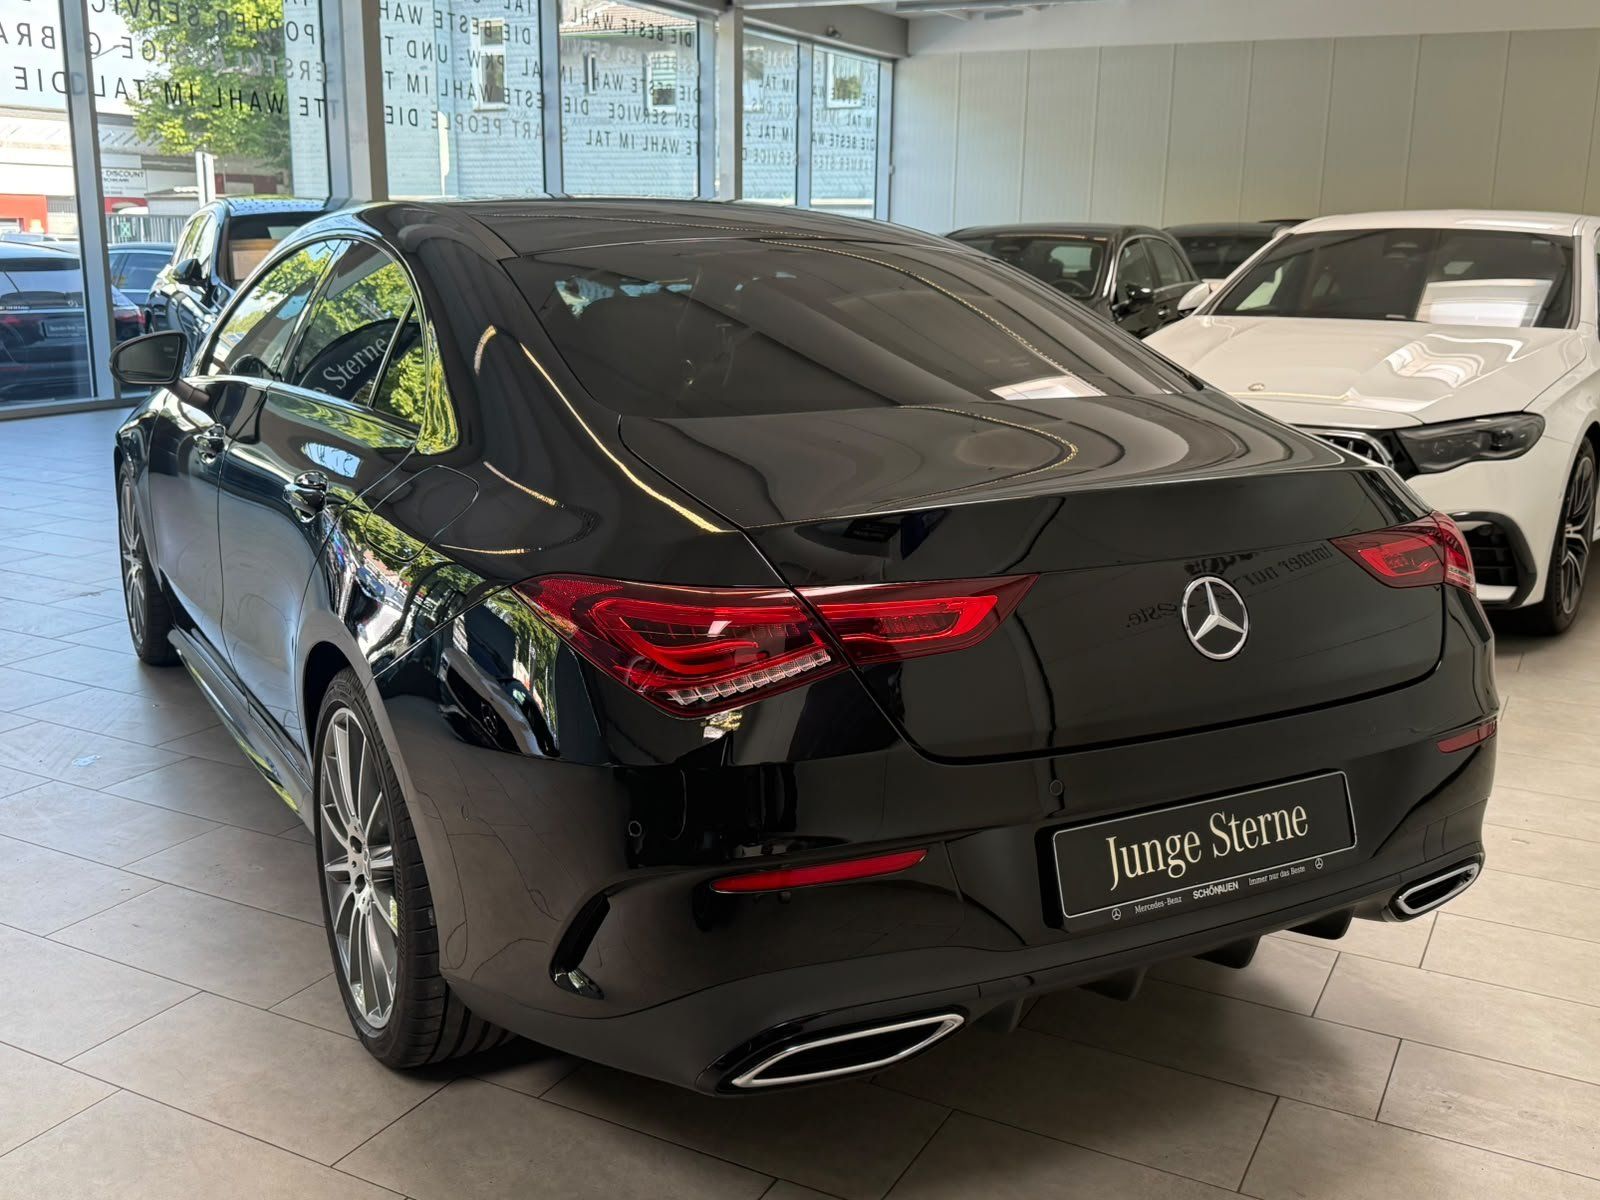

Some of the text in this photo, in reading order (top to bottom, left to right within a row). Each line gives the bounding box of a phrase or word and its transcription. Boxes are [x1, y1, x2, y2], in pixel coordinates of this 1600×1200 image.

[322, 338, 388, 390] Sterne
[1106, 805, 1309, 890] Junge Sterne
[1134, 896, 1183, 914] Mercedes-Benz
[1248, 875, 1268, 886] Immer
[1279, 870, 1290, 879] das
